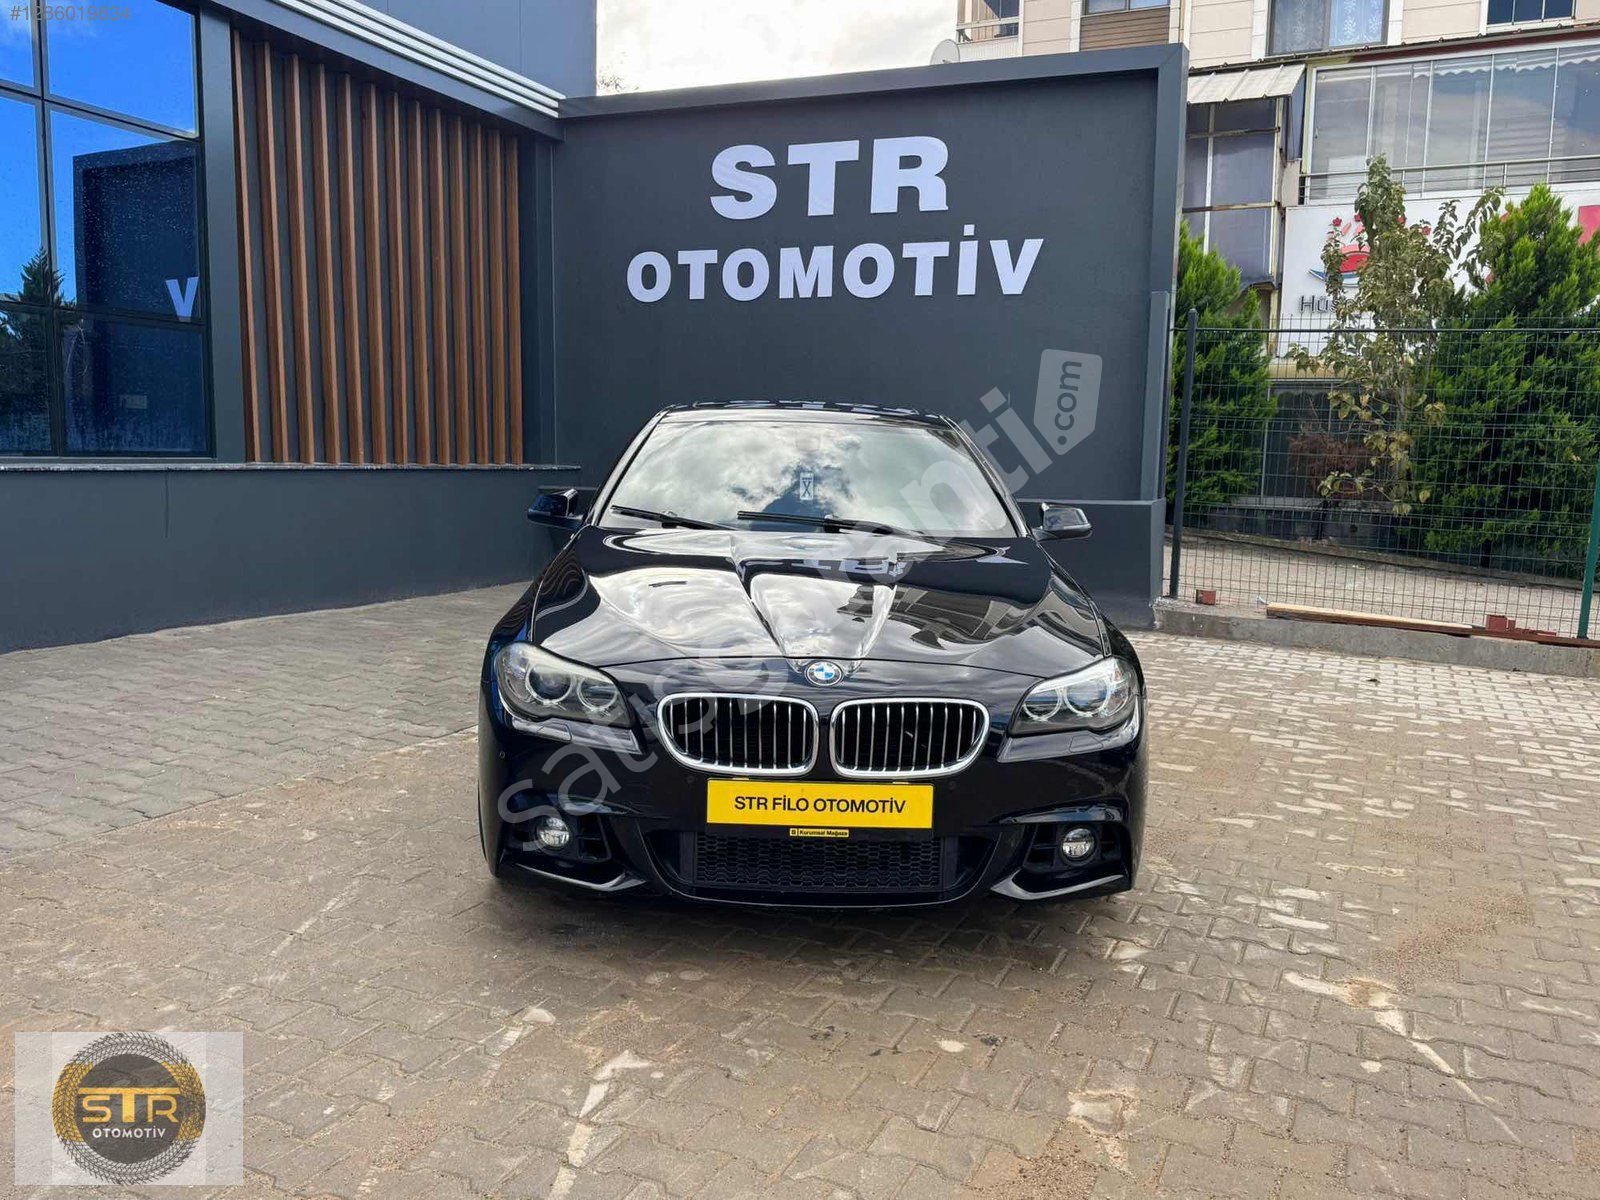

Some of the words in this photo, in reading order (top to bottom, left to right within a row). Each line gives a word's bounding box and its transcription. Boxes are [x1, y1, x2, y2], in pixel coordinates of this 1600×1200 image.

[709, 135, 949, 220] STR
[626, 224, 1044, 303] OTOMOTİV
[734, 795, 768, 811] STR
[772, 794, 809, 812] FİLO
[813, 797, 906, 814] OTOMOTİV
